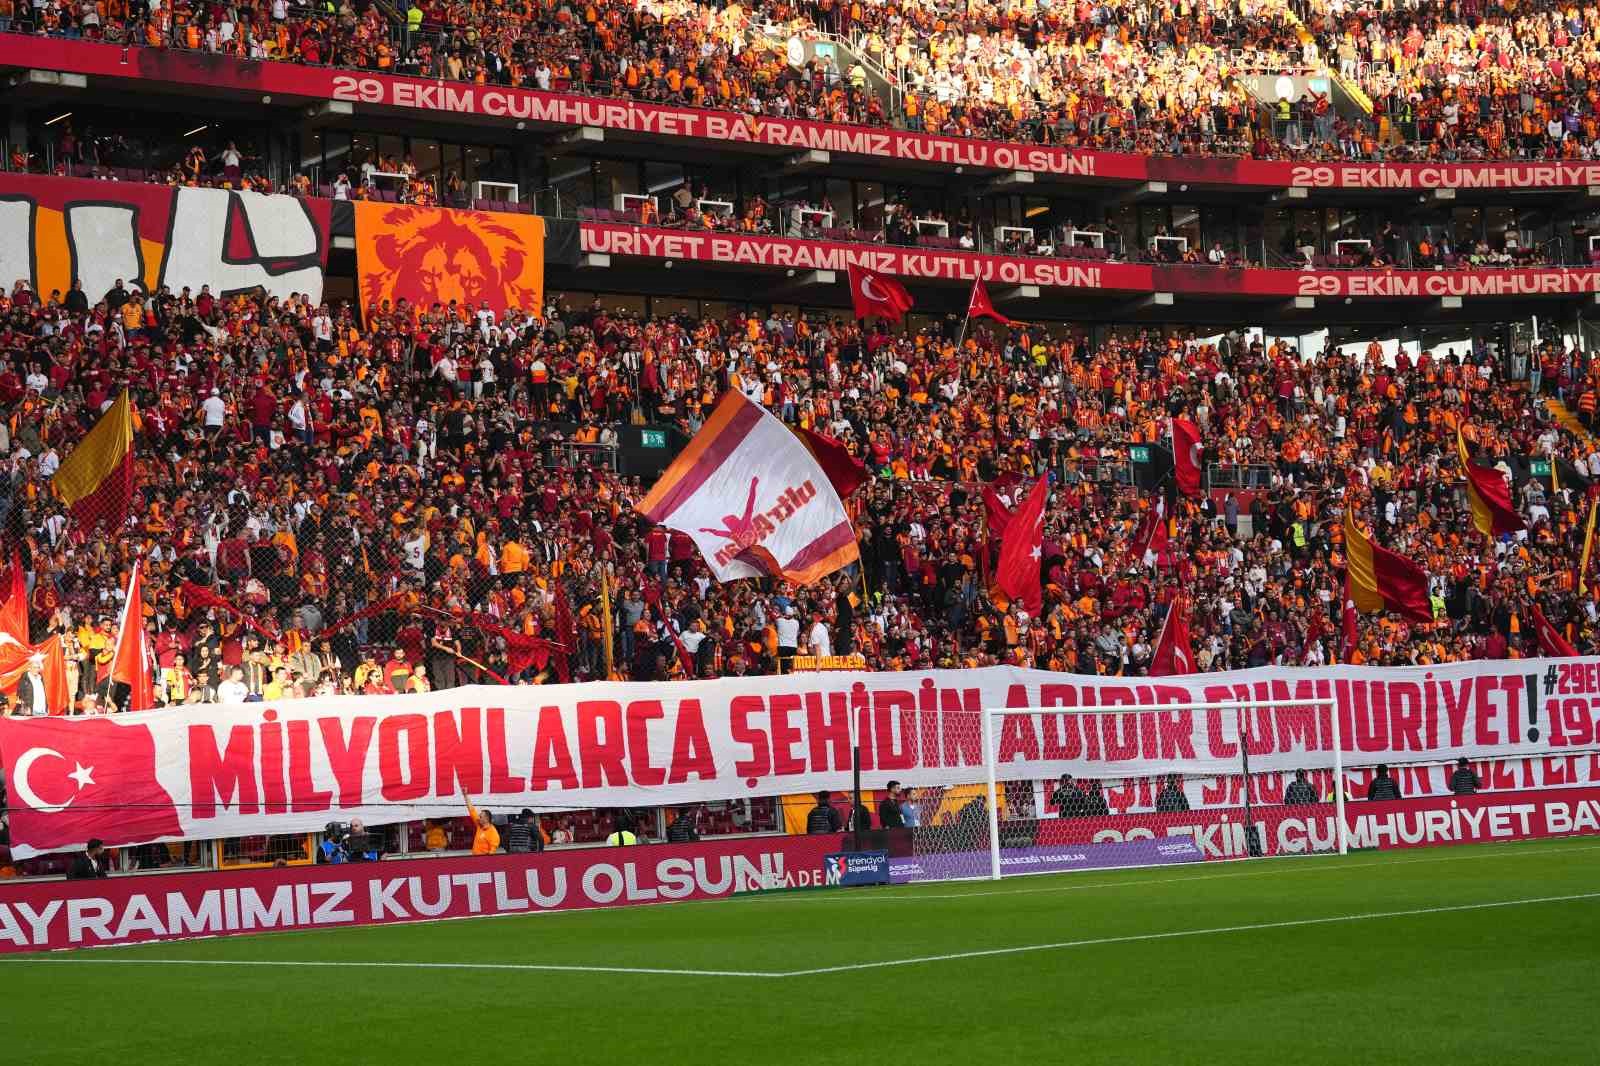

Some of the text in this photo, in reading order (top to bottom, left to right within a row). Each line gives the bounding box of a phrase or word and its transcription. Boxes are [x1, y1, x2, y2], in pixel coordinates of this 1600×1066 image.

[332, 76, 1096, 176] 29 EKİM CUMHURİYET BAYRAMIMIZ KUTLU OLSUN!
[1292, 166, 1335, 188] 29
[1341, 162, 1412, 188] EKİM
[711, 238, 897, 275] BAYRAMIMIZ
[902, 254, 994, 281] KUTLU
[1000, 261, 1102, 288] OLSUN!
[1298, 275, 1341, 296] 29
[1348, 270, 1419, 297] EKİM
[1543, 662, 1600, 696] #29E
[188, 671, 1541, 820] MİLYONLARCA ŞEHİDİN ADIDIR CUMHURİYET!
[1276, 799, 1537, 854] CUMHURİYET
[847, 855, 886, 866] trendyol
[368, 866, 568, 921] KUTLU
[582, 852, 785, 904] OLSUN!
